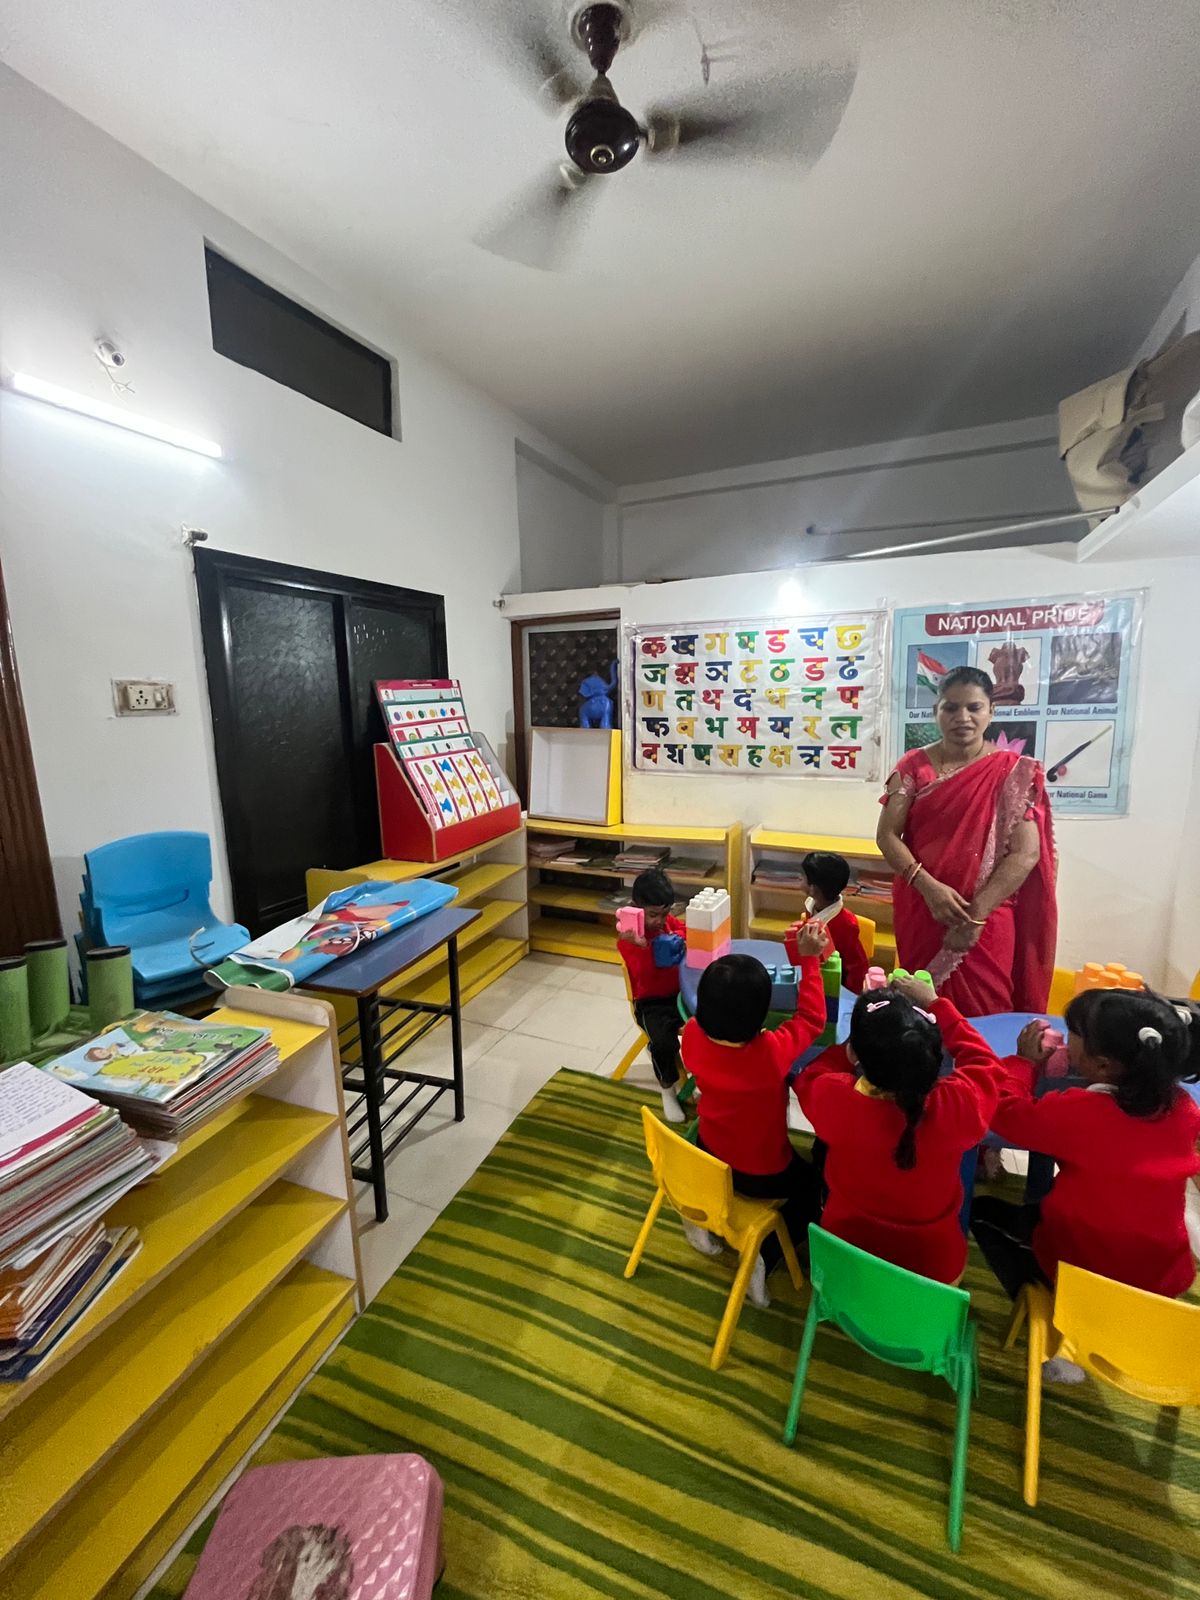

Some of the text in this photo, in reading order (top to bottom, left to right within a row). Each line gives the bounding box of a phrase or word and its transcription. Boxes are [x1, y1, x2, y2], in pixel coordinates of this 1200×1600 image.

[938, 605, 1089, 630] NATIONAL PRIDE
[641, 636, 667, 658] क
[704, 632, 729, 655] ग
[798, 627, 828, 650] च
[835, 625, 866, 650] छ
[641, 664, 669, 685] ज
[739, 660, 762, 683] ट
[769, 658, 795, 682] ठ
[803, 657, 828, 681] ड
[836, 656, 864, 680] ढ
[641, 686, 863, 712] ण त थ द ध न प
[1046, 705, 1118, 716] Our National Animal
[641, 717, 669, 737] फ
[705, 717, 728, 738] भ
[736, 717, 760, 739] म
[768, 717, 793, 739] य
[802, 716, 821, 739] र
[829, 716, 862, 739] ल
[663, 744, 687, 765] श
[691, 744, 713, 765] ष
[716, 744, 743, 767] स
[746, 744, 766, 768] ह
[1057, 790, 1086, 798] National
[1088, 790, 1108, 799] Game
